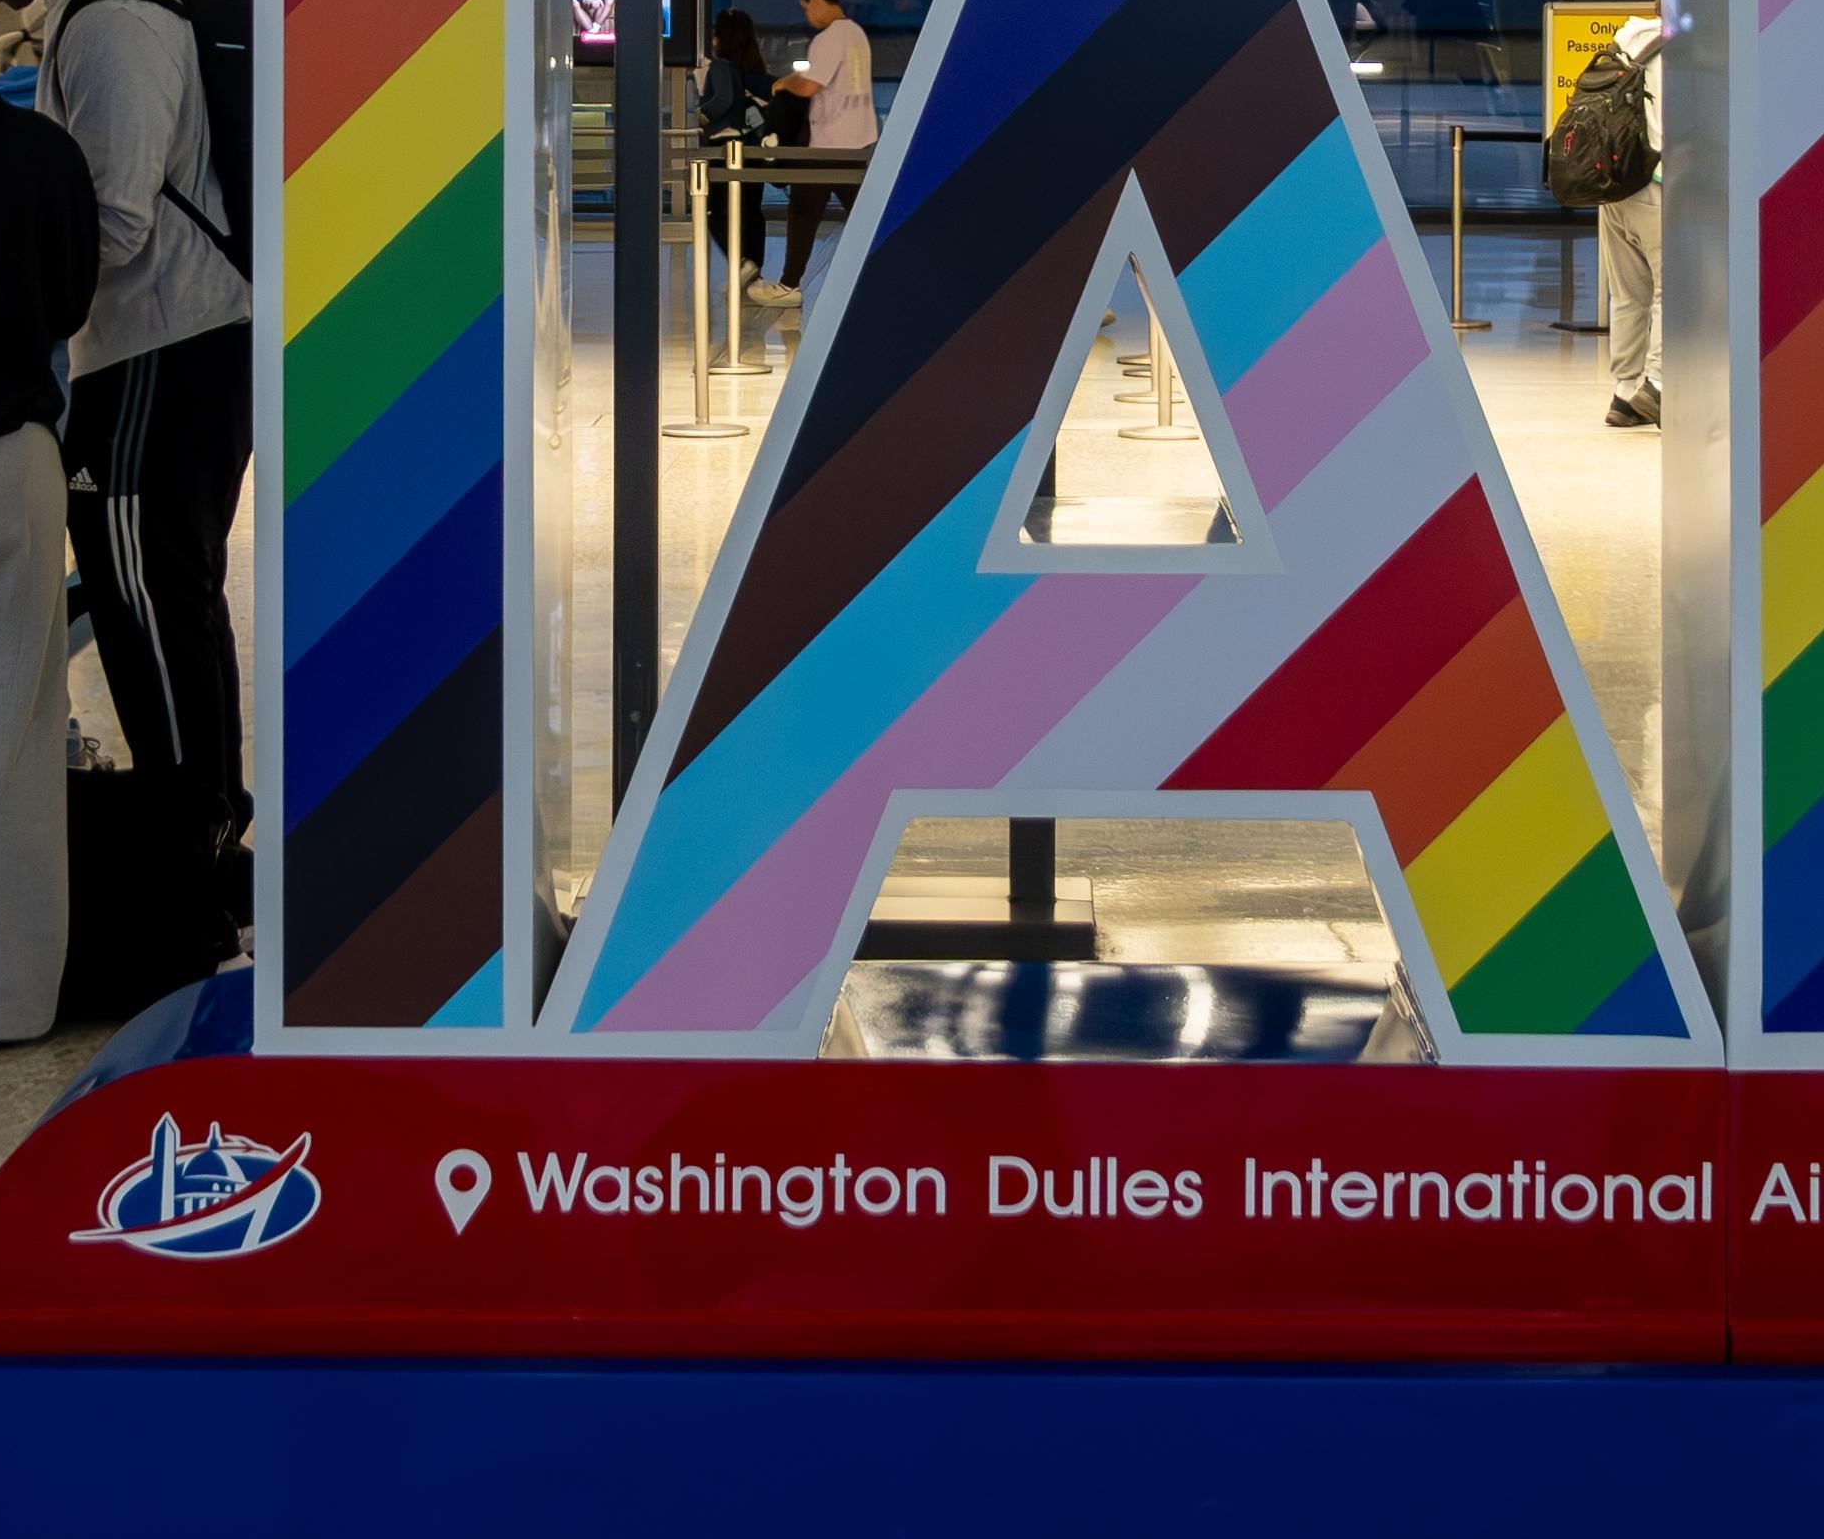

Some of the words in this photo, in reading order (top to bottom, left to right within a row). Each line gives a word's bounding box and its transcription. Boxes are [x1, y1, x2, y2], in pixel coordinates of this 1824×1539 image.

[1590, 21, 1619, 37] Only
[517, 1151, 947, 1228] Washington
[989, 1155, 1204, 1218] Dulles
[1245, 1157, 1713, 1222] International
